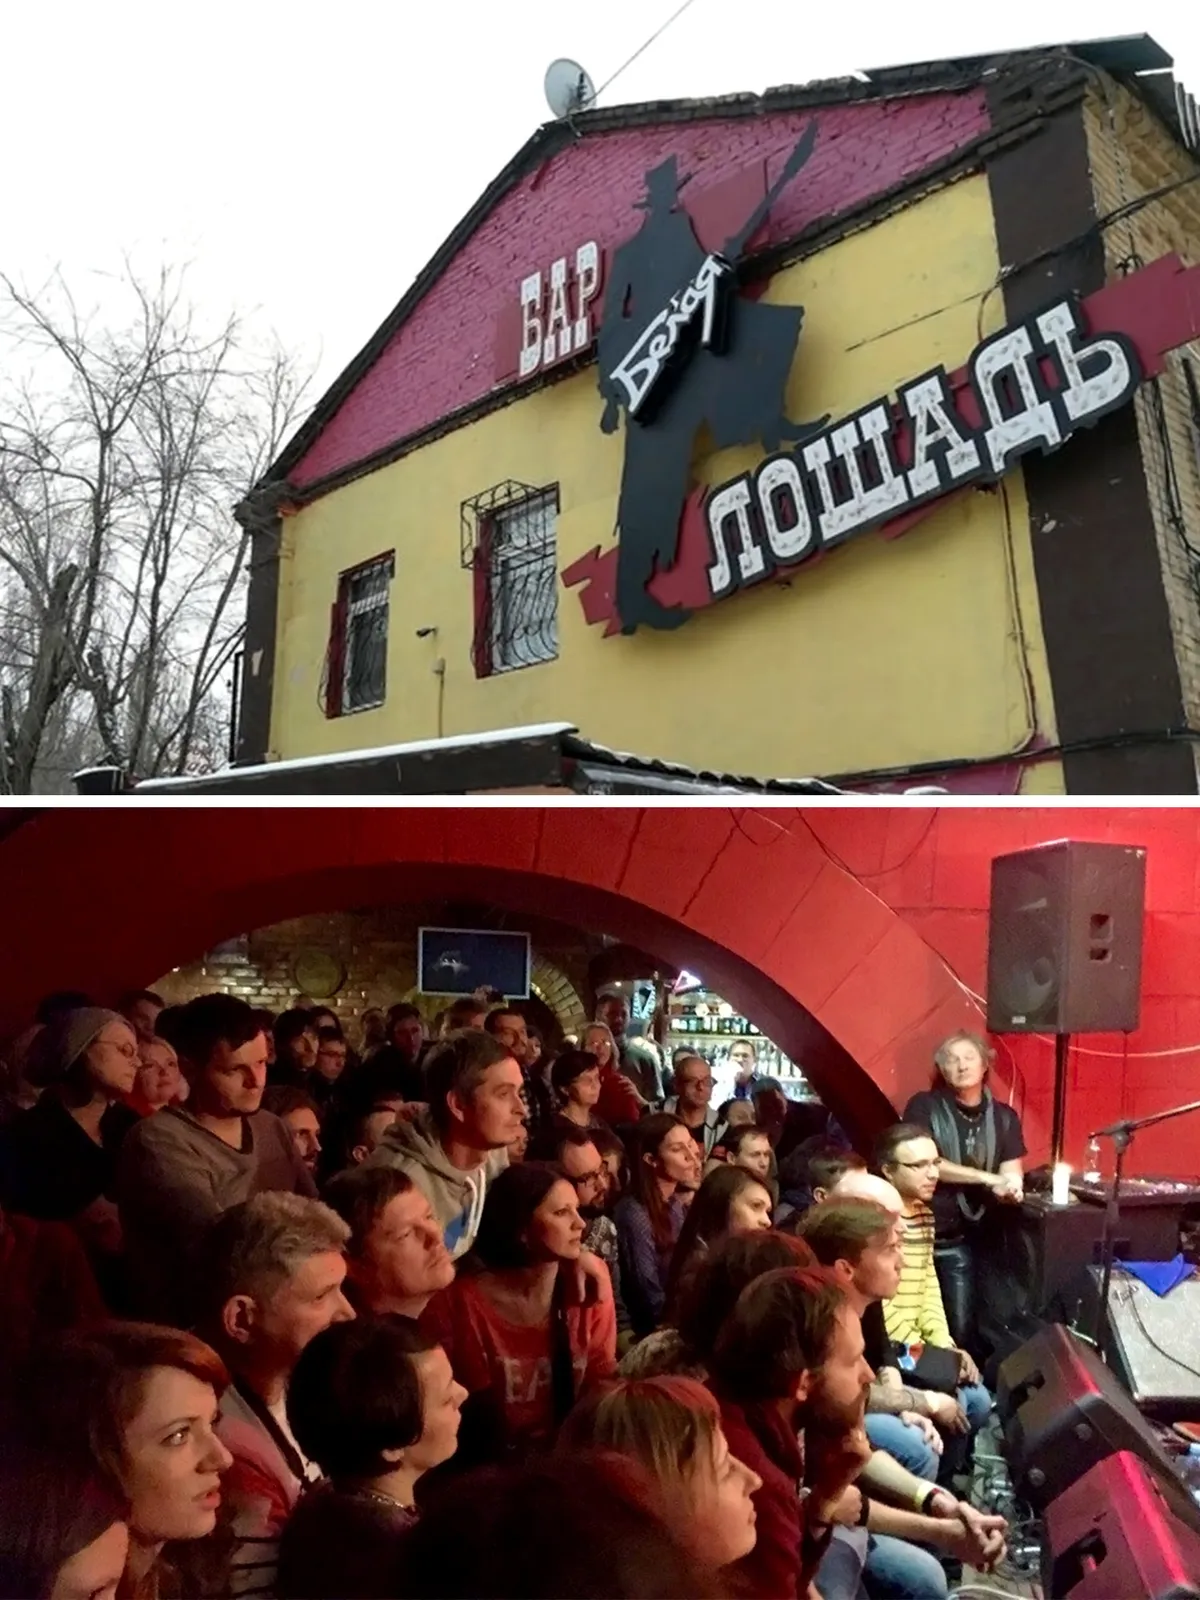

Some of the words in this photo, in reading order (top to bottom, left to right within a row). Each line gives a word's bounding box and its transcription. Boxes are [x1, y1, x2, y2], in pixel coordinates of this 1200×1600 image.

[519, 240, 599, 377] БАР
[609, 251, 727, 413] Белая
[707, 300, 1132, 593] ЛОШАДЬ
